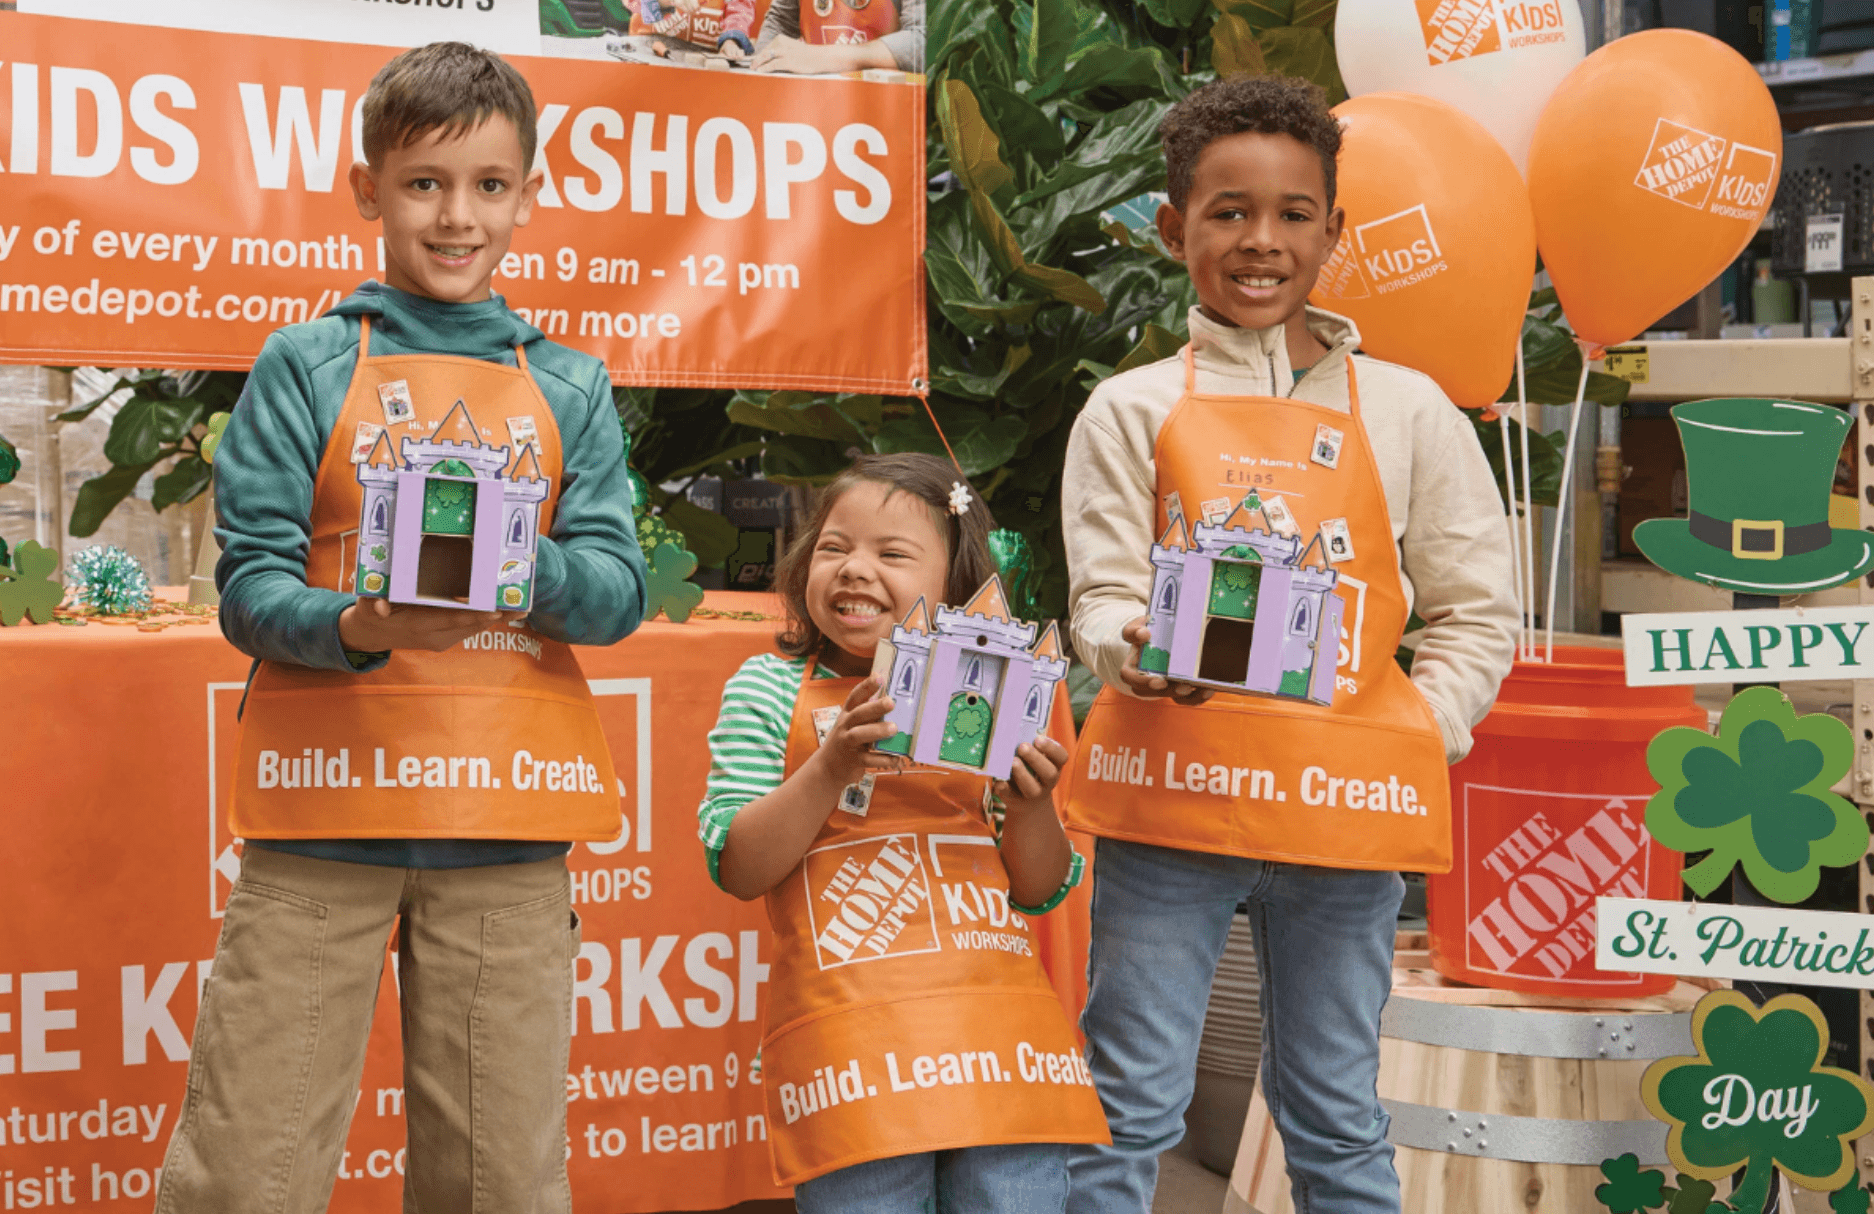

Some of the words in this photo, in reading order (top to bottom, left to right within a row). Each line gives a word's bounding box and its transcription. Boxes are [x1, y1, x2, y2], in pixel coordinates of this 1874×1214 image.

[1427, 0, 1489, 62] HOM
[1502, 3, 1557, 33] KIDS
[1508, 32, 1565, 49] WORKSHOPS
[0, 61, 199, 185] IDS
[1658, 135, 1692, 158] THE
[1641, 136, 1722, 190] HOME
[1666, 165, 1715, 197] DEPOT
[1717, 174, 1766, 207] KIDS
[33, 219, 81, 255] of
[92, 230, 219, 271] every
[231, 234, 363, 271] month
[556, 246, 578, 282] 9
[588, 257, 640, 285] am
[680, 254, 727, 287] 12
[738, 262, 800, 296] pm
[1364, 239, 1433, 280] KIDS
[1375, 260, 1448, 294] WORKSHOPS
[579, 311, 681, 338] more
[1220, 453, 1236, 464] Hi,
[1239, 455, 1257, 466] My
[1260, 457, 1294, 469] Name
[1297, 461, 1308, 471] Is
[1226, 469, 1274, 485] Elias
[1645, 621, 1870, 673] HAPPY
[258, 748, 361, 789] Build.
[374, 748, 501, 788] Learn.
[511, 750, 604, 794] Create.
[1088, 743, 1153, 787] Build.
[1165, 751, 1287, 802] Learn.
[1300, 765, 1428, 817] Create.
[1481, 811, 1563, 882] THE
[816, 836, 921, 961] HOME
[820, 855, 866, 905] THE
[1467, 798, 1650, 974] HOME
[864, 878, 928, 955] DEPOT
[951, 930, 1033, 957] WORKSHOPS
[1612, 910, 1678, 961] St.
[1696, 915, 1874, 976] Patrick
[724, 1051, 739, 1089] 9
[779, 1059, 878, 1125] Build.
[885, 1050, 1011, 1093] Learn.
[1702, 1073, 1820, 1139] Day
[0, 1163, 75, 1210] isit
[584, 1122, 627, 1159] to
[640, 1114, 738, 1154] learn
